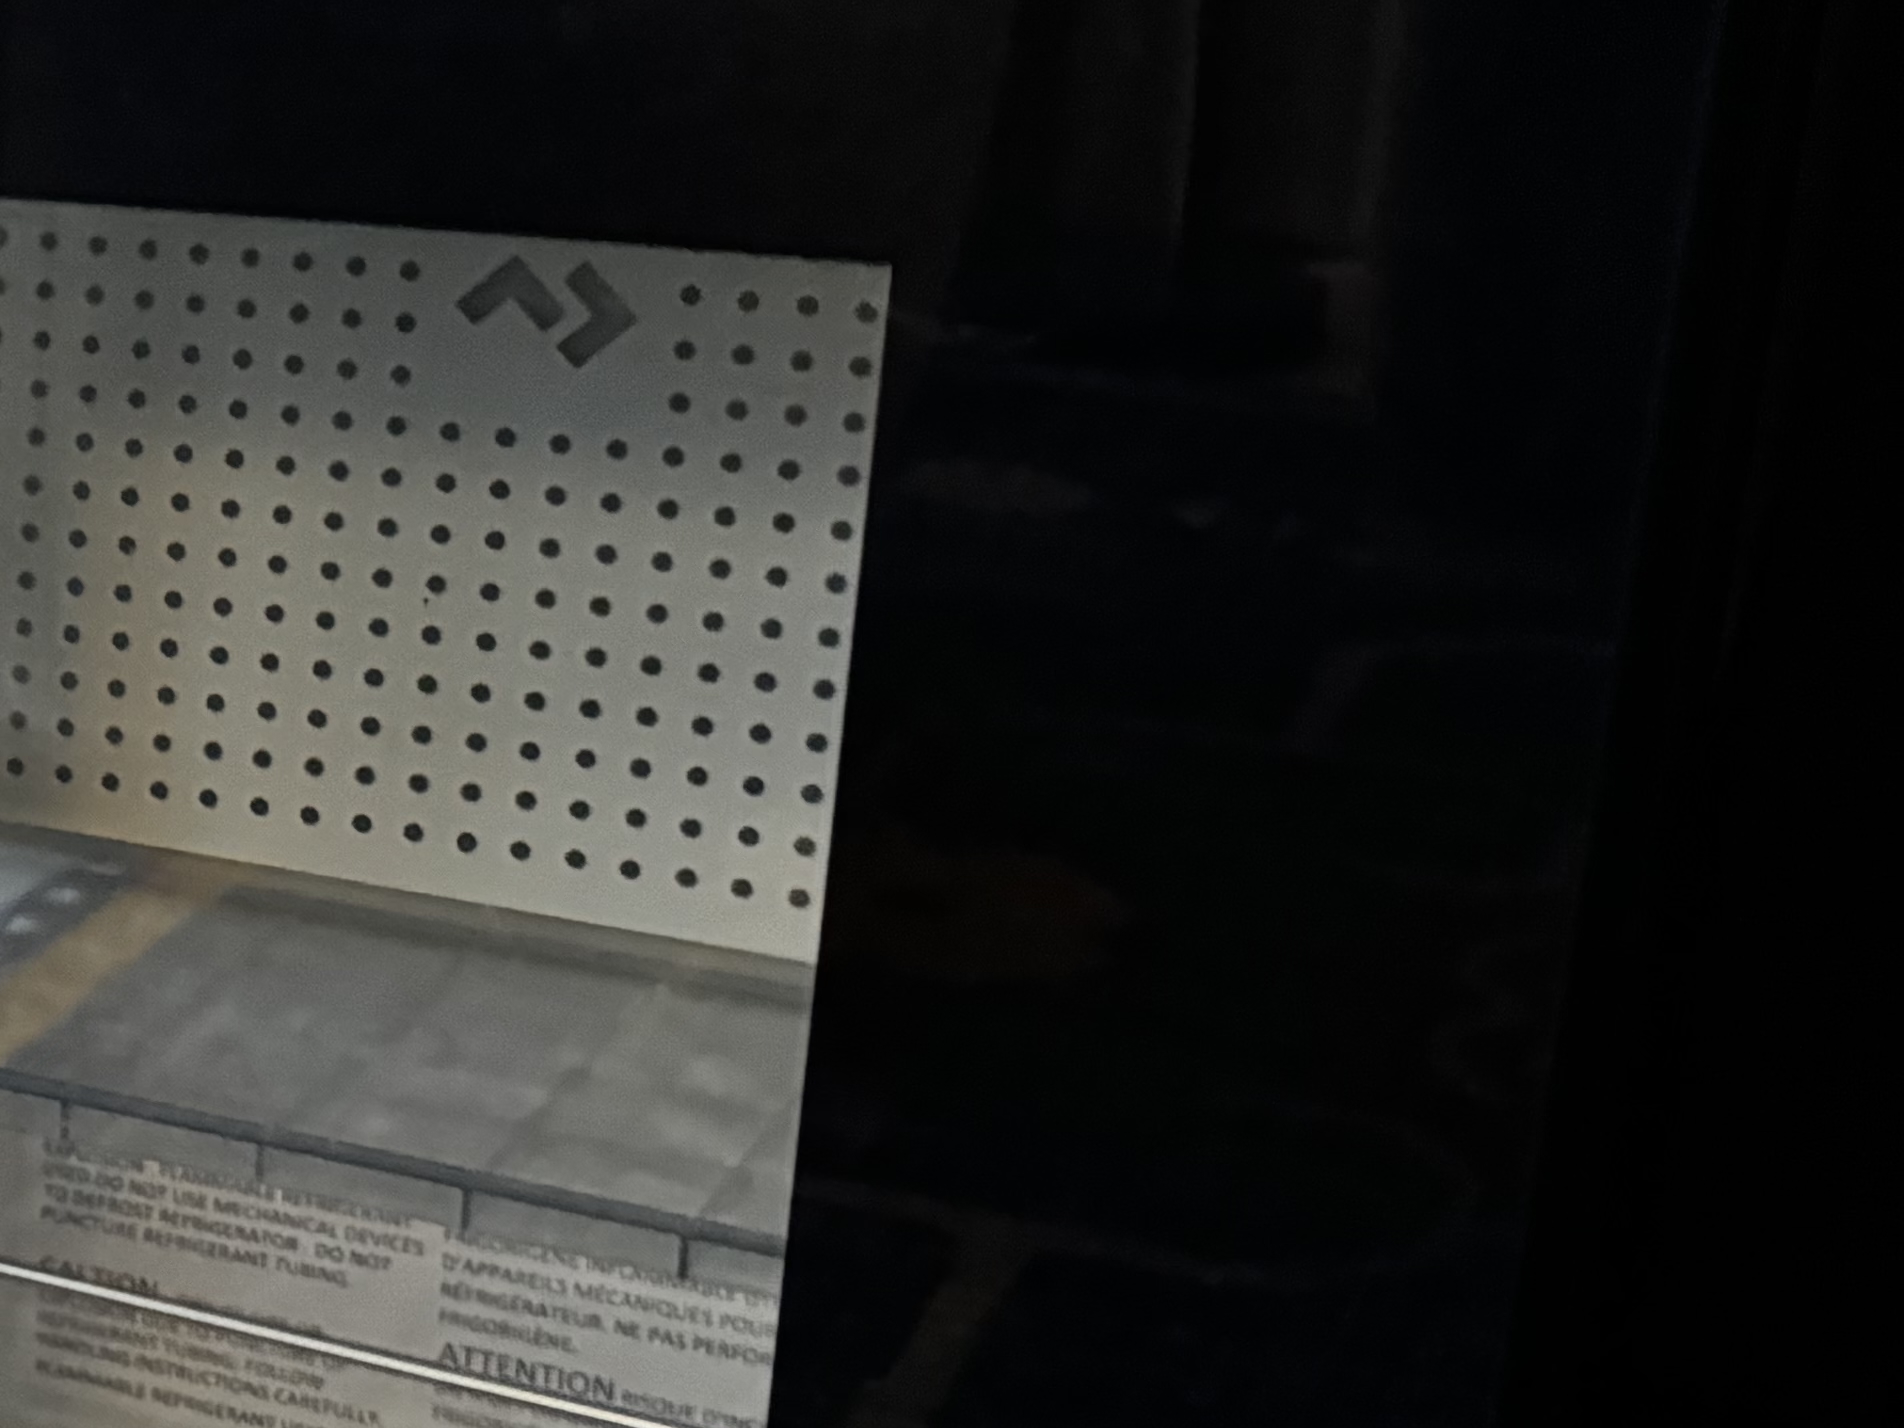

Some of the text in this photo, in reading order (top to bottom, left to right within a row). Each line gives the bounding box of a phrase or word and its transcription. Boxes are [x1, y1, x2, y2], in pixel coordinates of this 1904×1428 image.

[43, 1182, 70, 1204] TO
[314, 1242, 345, 1264] DO
[349, 1249, 392, 1272] NOT
[128, 1178, 168, 1201] NOT
[172, 1186, 208, 1210] USE
[213, 1196, 338, 1240] MECHANICAL
[344, 1224, 425, 1257] DEVICES
[143, 1225, 269, 1269] REFRIGERANT
[613, 1318, 640, 1341] NE
[646, 1325, 687, 1352] PAS
[439, 1341, 616, 1402] ATTENTION
